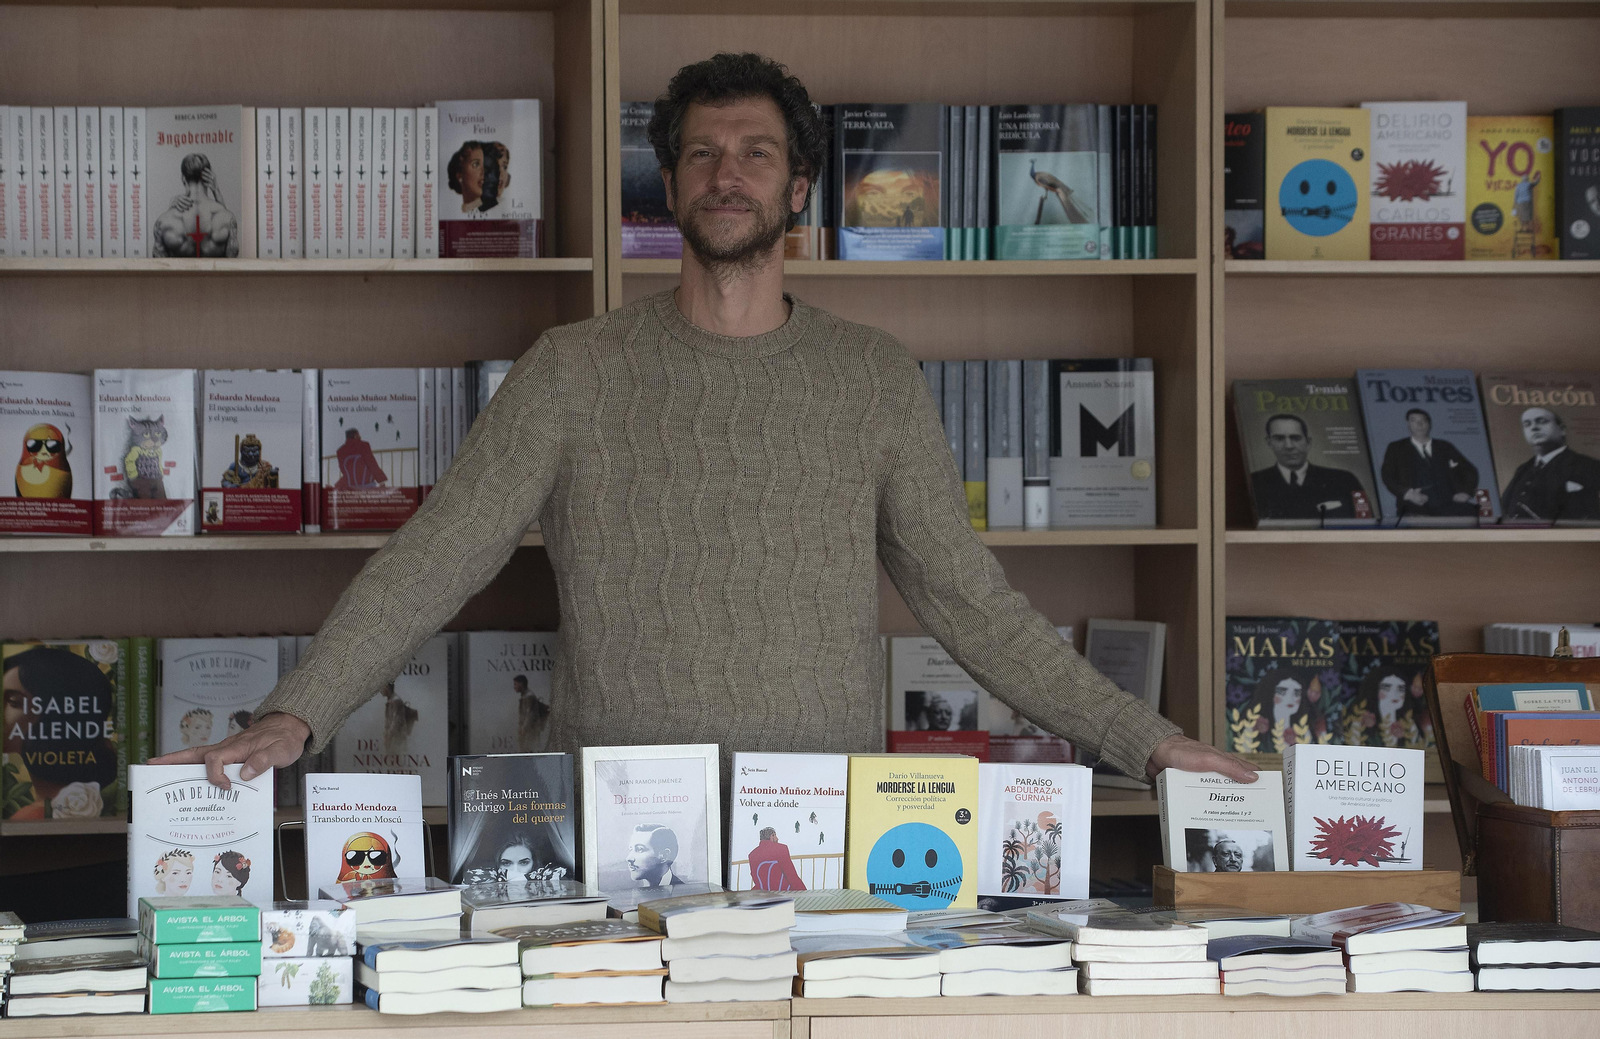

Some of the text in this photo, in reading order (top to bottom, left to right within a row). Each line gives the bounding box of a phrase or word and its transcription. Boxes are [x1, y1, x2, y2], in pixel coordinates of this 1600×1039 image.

[175, 113, 196, 121] REBECA
[448, 113, 484, 125] Virginia
[1378, 113, 1452, 128] DELIRIO
[473, 124, 496, 134] Feito
[843, 120, 895, 130] TERRA ALTA
[999, 122, 1060, 130] UNA HISTORIA
[999, 130, 1041, 140] RIDÍCULA
[1287, 126, 1351, 136] MORDERSE LA LENGUA
[1377, 129, 1452, 140] AMERICANO
[156, 129, 234, 148] Ingobernable
[512, 199, 524, 210] La
[1377, 208, 1450, 221] CARLOS
[1374, 225, 1443, 242] GRANÉS
[1065, 379, 1102, 389] Antonio
[1424, 375, 1470, 386] Manuel
[1306, 384, 1348, 395] Tomás
[1368, 380, 1474, 402] Torres
[99, 394, 135, 402] Eduardo
[209, 393, 281, 402] Eduardo Mendoza
[328, 394, 360, 402] Antonio
[361, 394, 386, 402] Muñoz
[1490, 384, 1597, 406] Chacón
[36, 398, 71, 406] Mendoza
[0, 407, 40, 416] Transbordo
[217, 404, 252, 413] negociado
[265, 405, 276, 414] yin
[357, 404, 378, 412] dónde
[1080, 402, 1135, 457] M
[500, 644, 550, 657] JULIA
[1234, 636, 1334, 658] MALAS
[1338, 636, 1434, 656] MALAS
[487, 658, 555, 672] NAVARR
[1292, 659, 1334, 667] MUJERES
[22, 696, 102, 715] ISABEL
[8, 720, 114, 740] ALLENDE
[357, 739, 379, 751] DE
[26, 751, 97, 766] VIOLETA
[353, 754, 431, 768] NINGUNA
[462, 767, 472, 776] N
[1316, 760, 1406, 779] DELIRIO
[1016, 777, 1052, 786] PARAÍSO
[740, 786, 844, 796] Antonio Muñoz Molina
[876, 782, 956, 794] MORDERSE LA LENGUA
[1004, 786, 1063, 795] ABDULRAZAK
[1315, 780, 1405, 794] AMERICANO
[165, 786, 241, 805] PAN DE LIMÓN
[476, 789, 539, 800] Inés Martín
[614, 793, 689, 805] Diario íntimo
[922, 795, 946, 803] política
[1015, 794, 1052, 802] GURNAH
[1209, 792, 1245, 802] Diarios
[194, 804, 226, 813] semillas
[312, 803, 397, 811] Eduardo Mendoza
[463, 801, 566, 813] Rodrigo Las formas
[740, 799, 765, 807] Volver
[774, 799, 799, 808] dónde
[312, 815, 360, 823] Transbordo
[512, 814, 565, 825] del querer
[170, 830, 235, 840] CRISTINA CAMPOS
[166, 916, 198, 924] AVISTA
[218, 914, 248, 922] ÁRBOL
[169, 950, 200, 958] AVISTA
[220, 948, 250, 957] ÁRBOL
[214, 984, 244, 992] ÁRBOL
